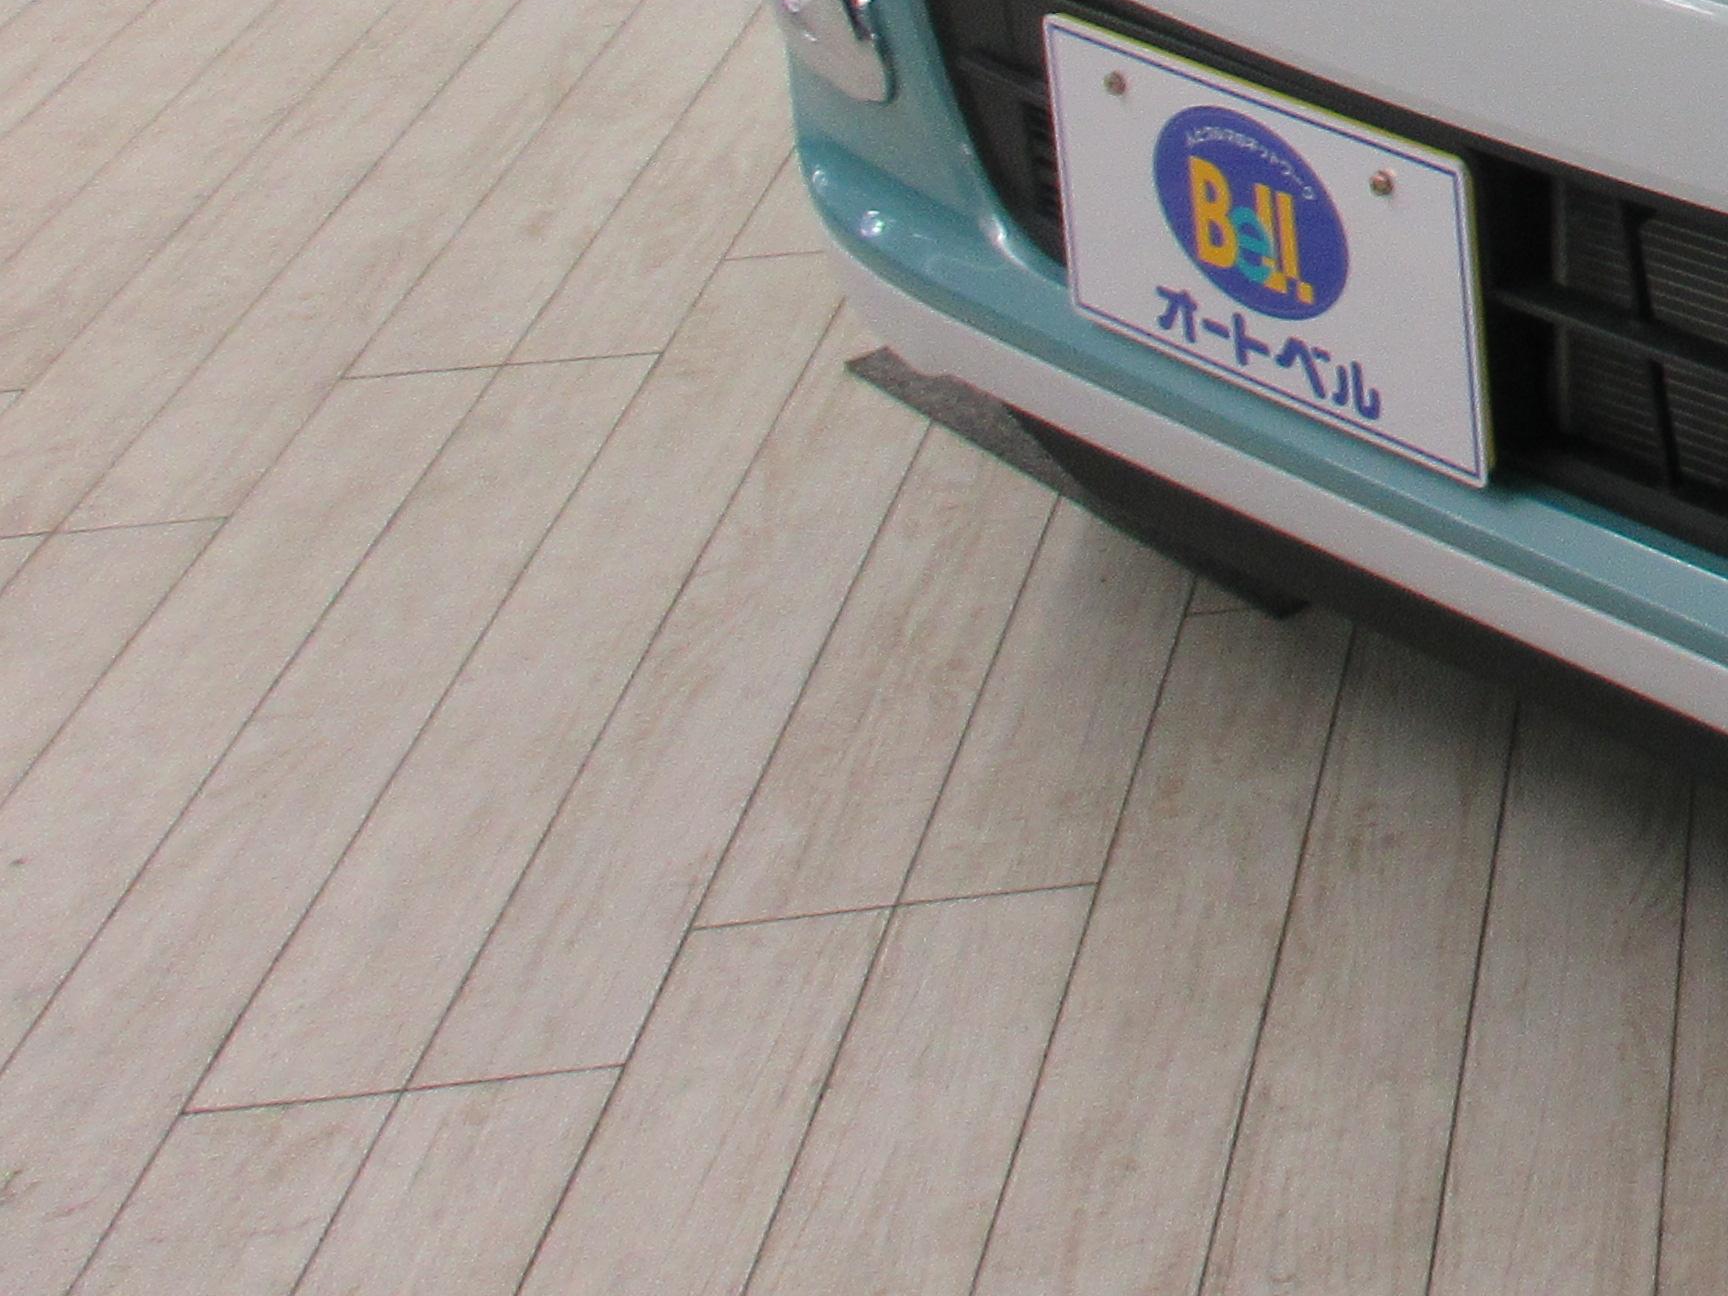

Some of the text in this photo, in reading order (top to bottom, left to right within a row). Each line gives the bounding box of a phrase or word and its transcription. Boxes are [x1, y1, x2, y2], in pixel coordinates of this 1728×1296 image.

[1156, 285, 1383, 421] オートベル
